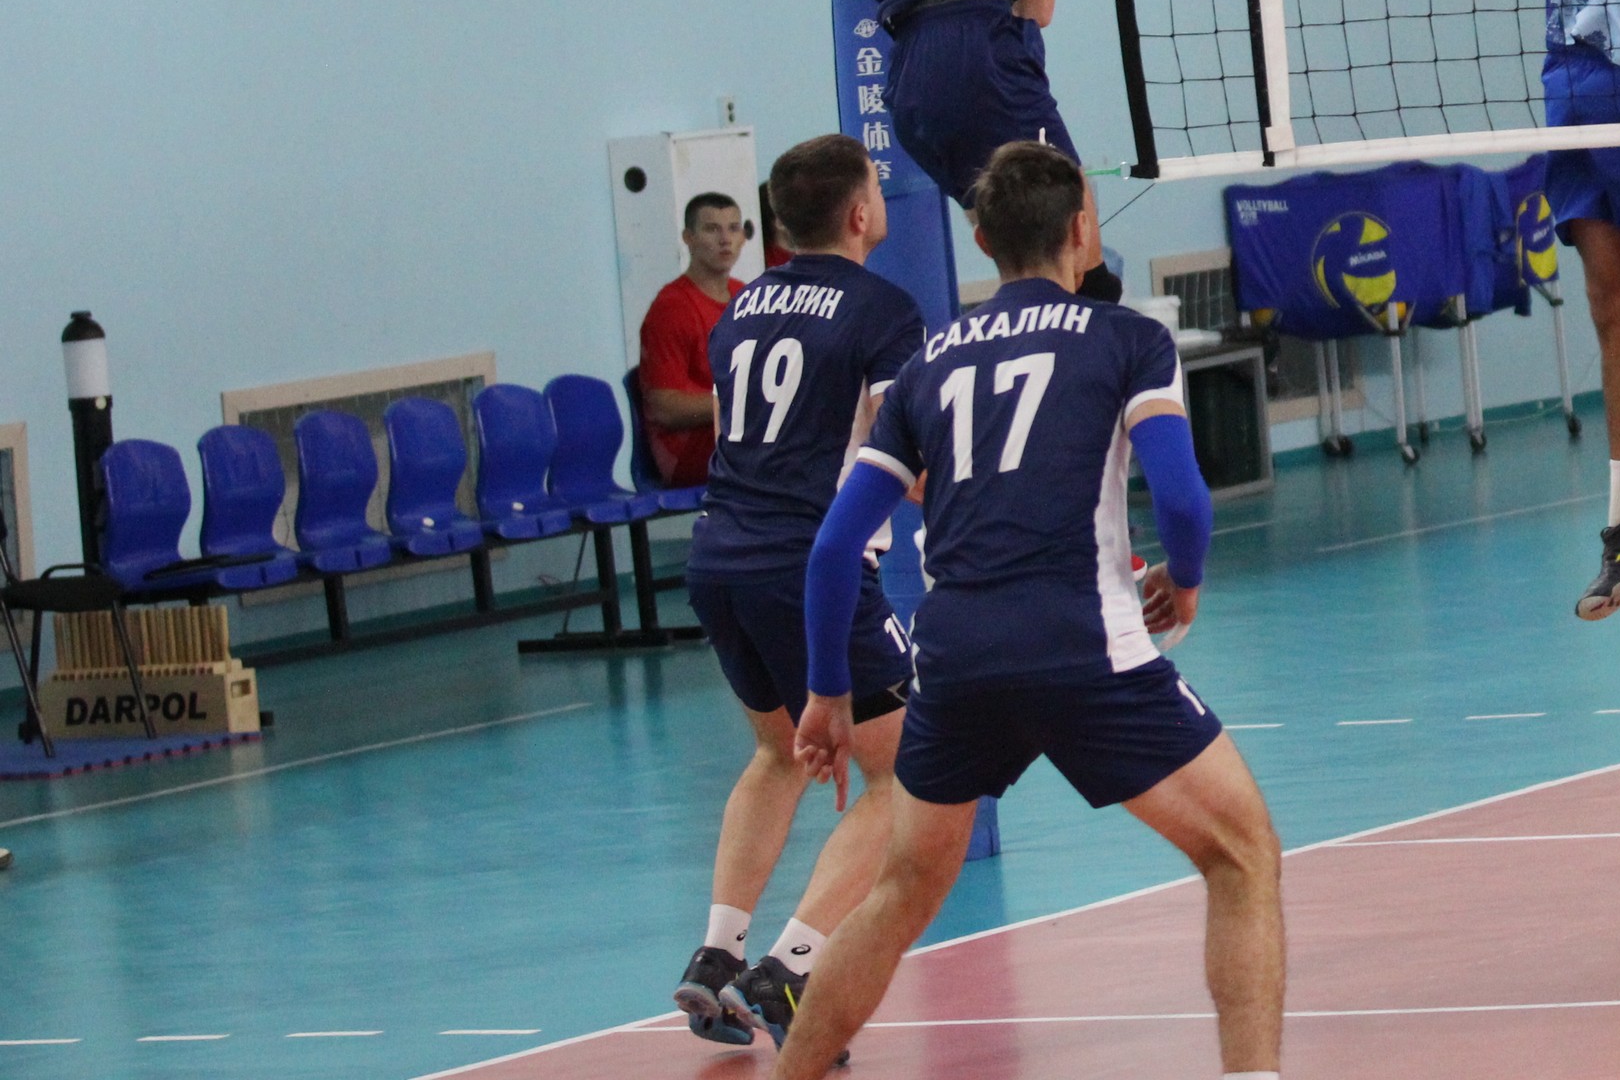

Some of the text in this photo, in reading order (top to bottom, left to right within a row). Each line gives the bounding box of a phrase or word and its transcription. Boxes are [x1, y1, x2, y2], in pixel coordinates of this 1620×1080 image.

[734, 284, 844, 320] САХАЛИН
[925, 303, 1093, 364] САХАЛИН
[728, 337, 804, 443] 19
[940, 352, 1056, 483] 17
[65, 692, 208, 726] DARPOL
